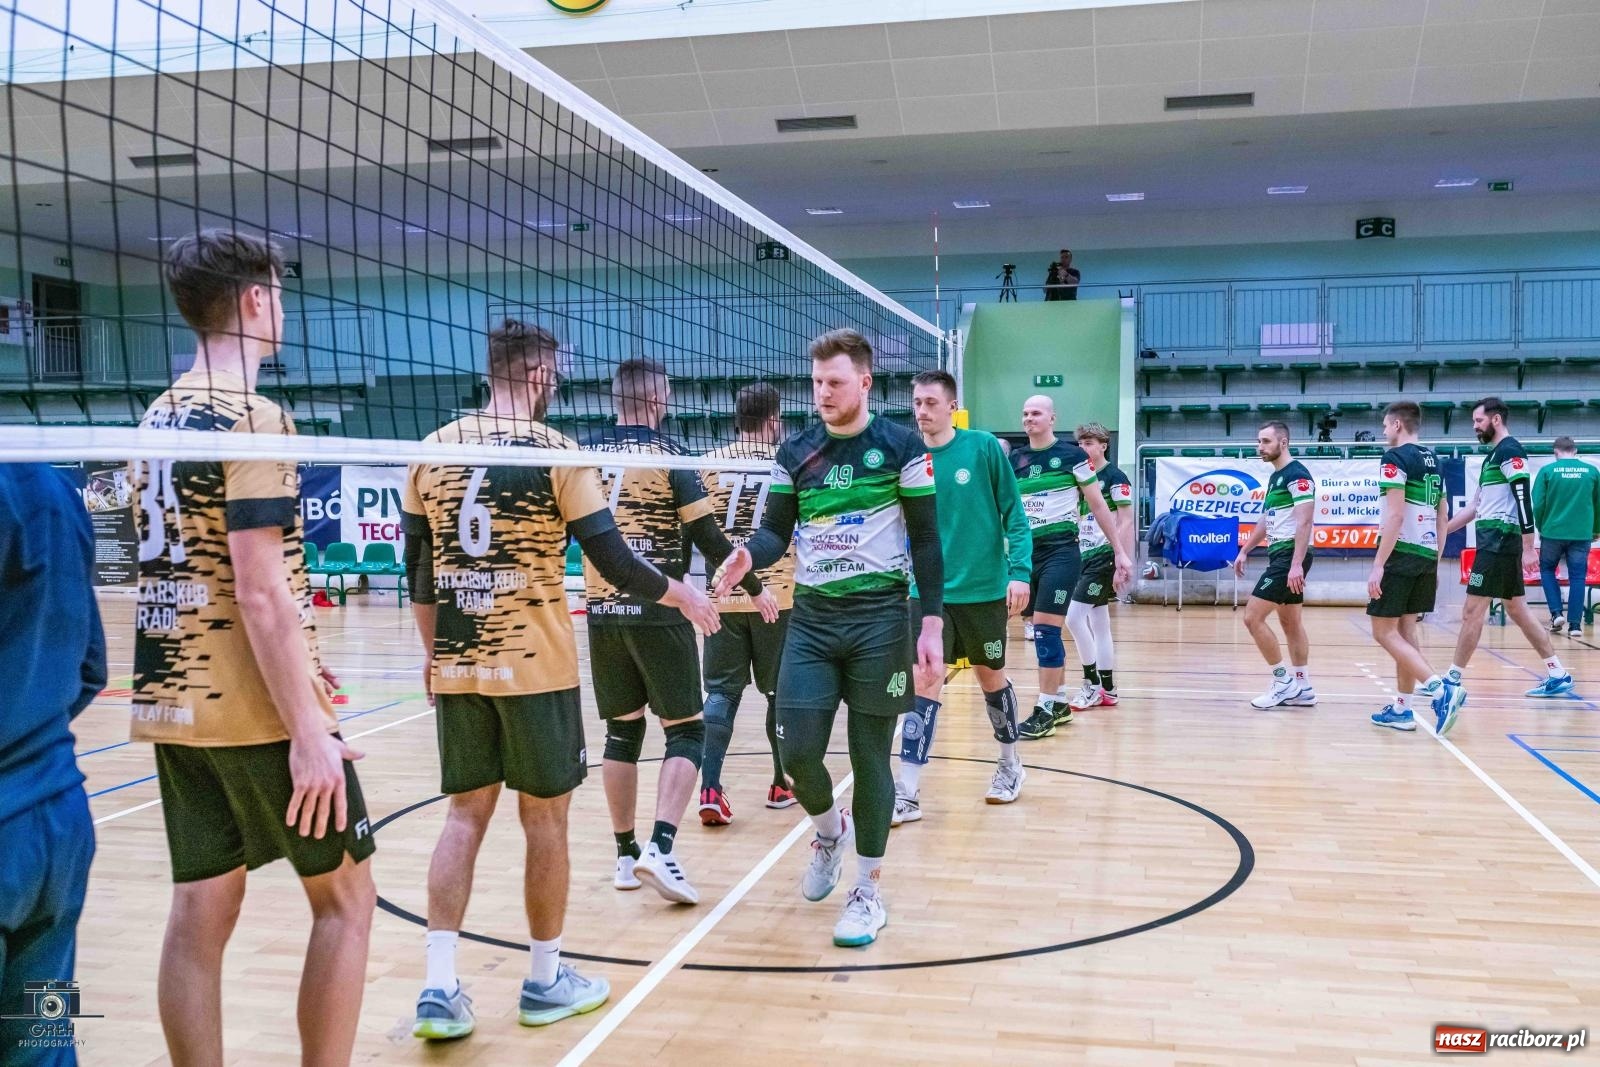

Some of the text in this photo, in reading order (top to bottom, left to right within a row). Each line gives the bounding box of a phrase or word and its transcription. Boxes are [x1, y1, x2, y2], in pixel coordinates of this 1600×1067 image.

[1360, 224, 1374, 237] C
[1381, 224, 1393, 236] C
[823, 464, 854, 489] 49
[1029, 464, 1043, 479] 19
[1321, 478, 1350, 488] Biura
[1352, 480, 1362, 488] w
[719, 473, 772, 529] 77
[1332, 493, 1379, 504] ul. Opaw
[459, 467, 492, 557] 6
[1331, 506, 1345, 516] ul.
[1188, 532, 1231, 544] molten
[1330, 529, 1379, 545] 570 77
[627, 538, 653, 551] KLUB
[1260, 577, 1273, 590] 7
[1054, 589, 1068, 605] 19
[591, 604, 603, 615] WE
[626, 605, 642, 615] FUN
[983, 639, 1003, 660] 99
[886, 671, 907, 698] 49
